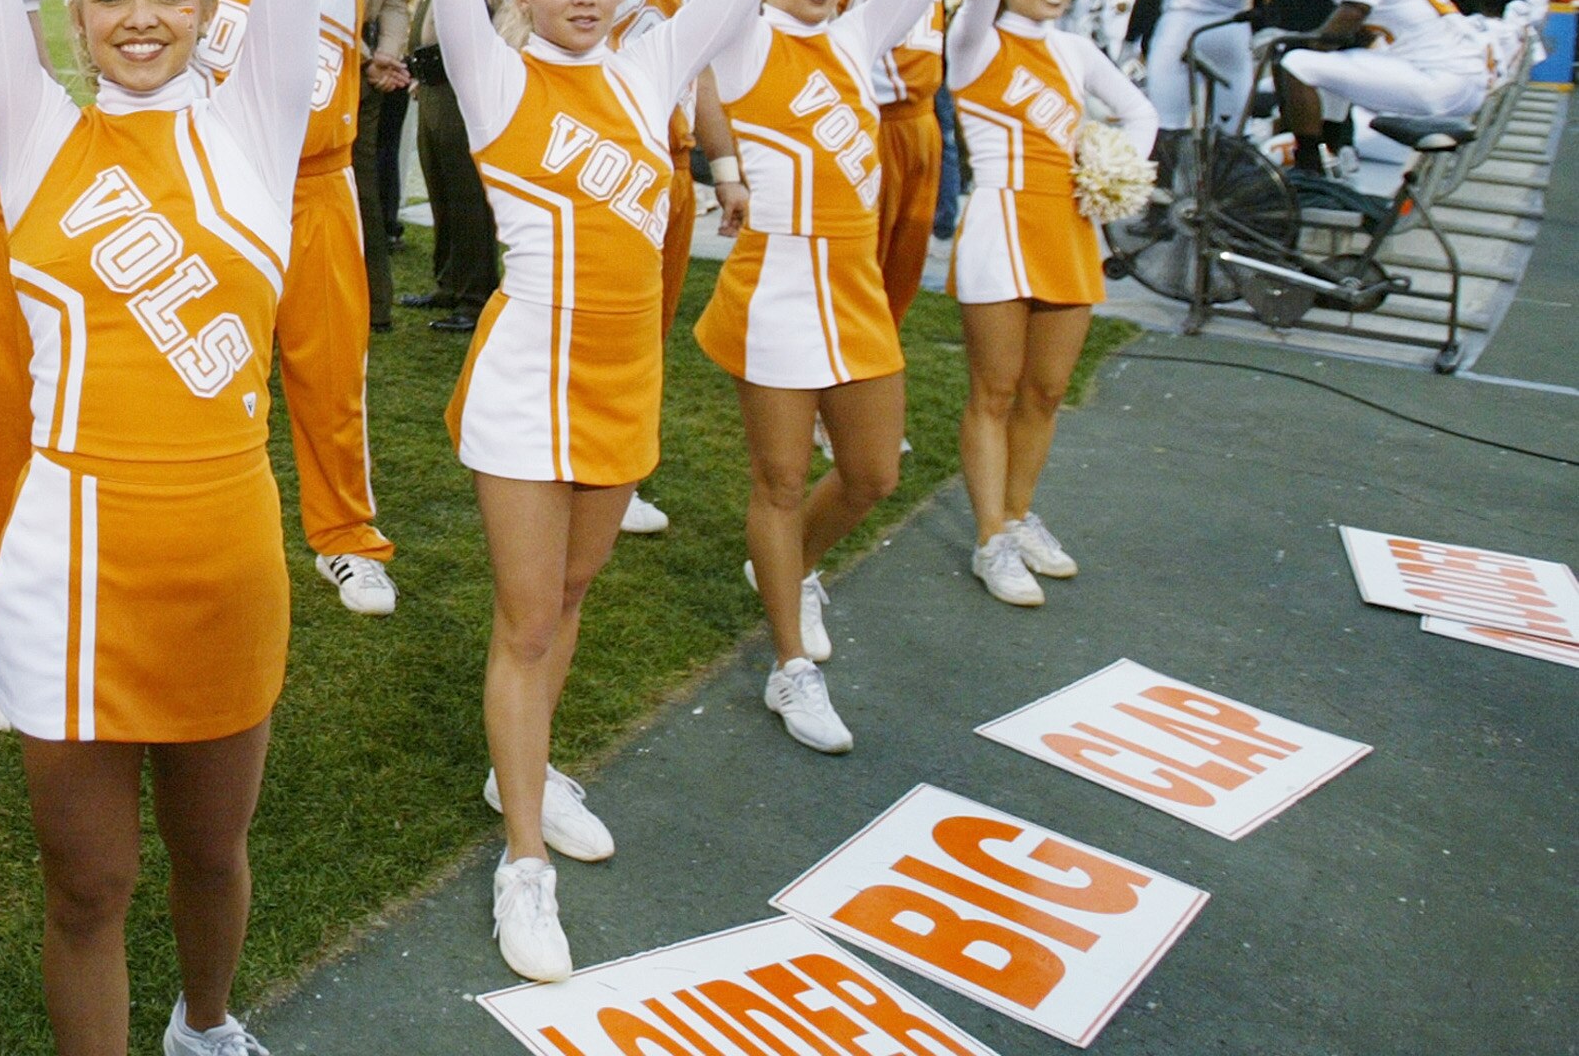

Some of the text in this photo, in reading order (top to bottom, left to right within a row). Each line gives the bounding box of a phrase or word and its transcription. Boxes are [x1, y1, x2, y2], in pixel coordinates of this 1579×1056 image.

[540, 111, 671, 251] VOLS
[58, 164, 254, 399] VOLS
[1387, 538, 1574, 638] LOUDER
[1039, 685, 1304, 809] CLAP
[831, 815, 1154, 1011] BIG
[537, 953, 989, 1056] DER
